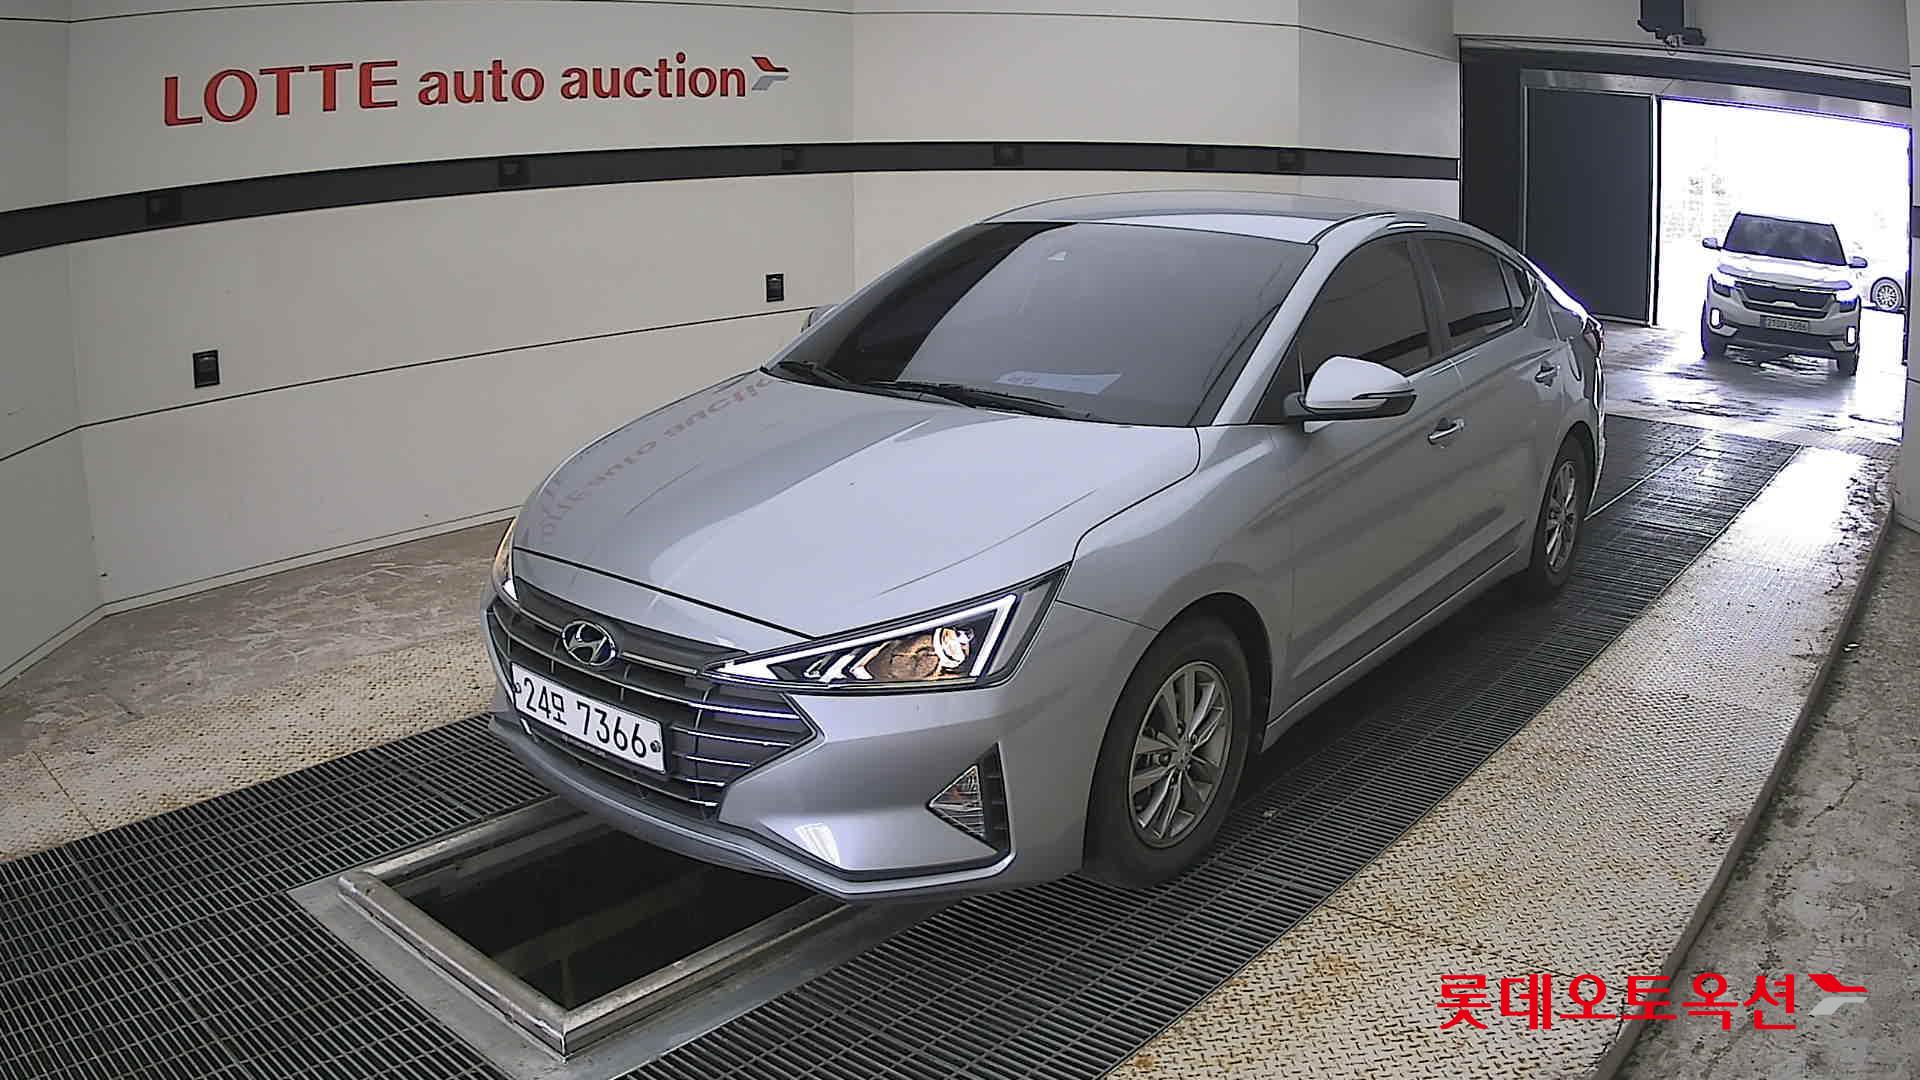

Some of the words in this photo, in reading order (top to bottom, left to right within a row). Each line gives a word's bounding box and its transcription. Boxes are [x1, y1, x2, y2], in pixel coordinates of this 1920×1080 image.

[163, 61, 400, 127] LOTTE
[417, 60, 545, 106] auto
[560, 52, 747, 98] auction
[523, 677, 567, 726] 24모
[576, 700, 647, 759] 7366
